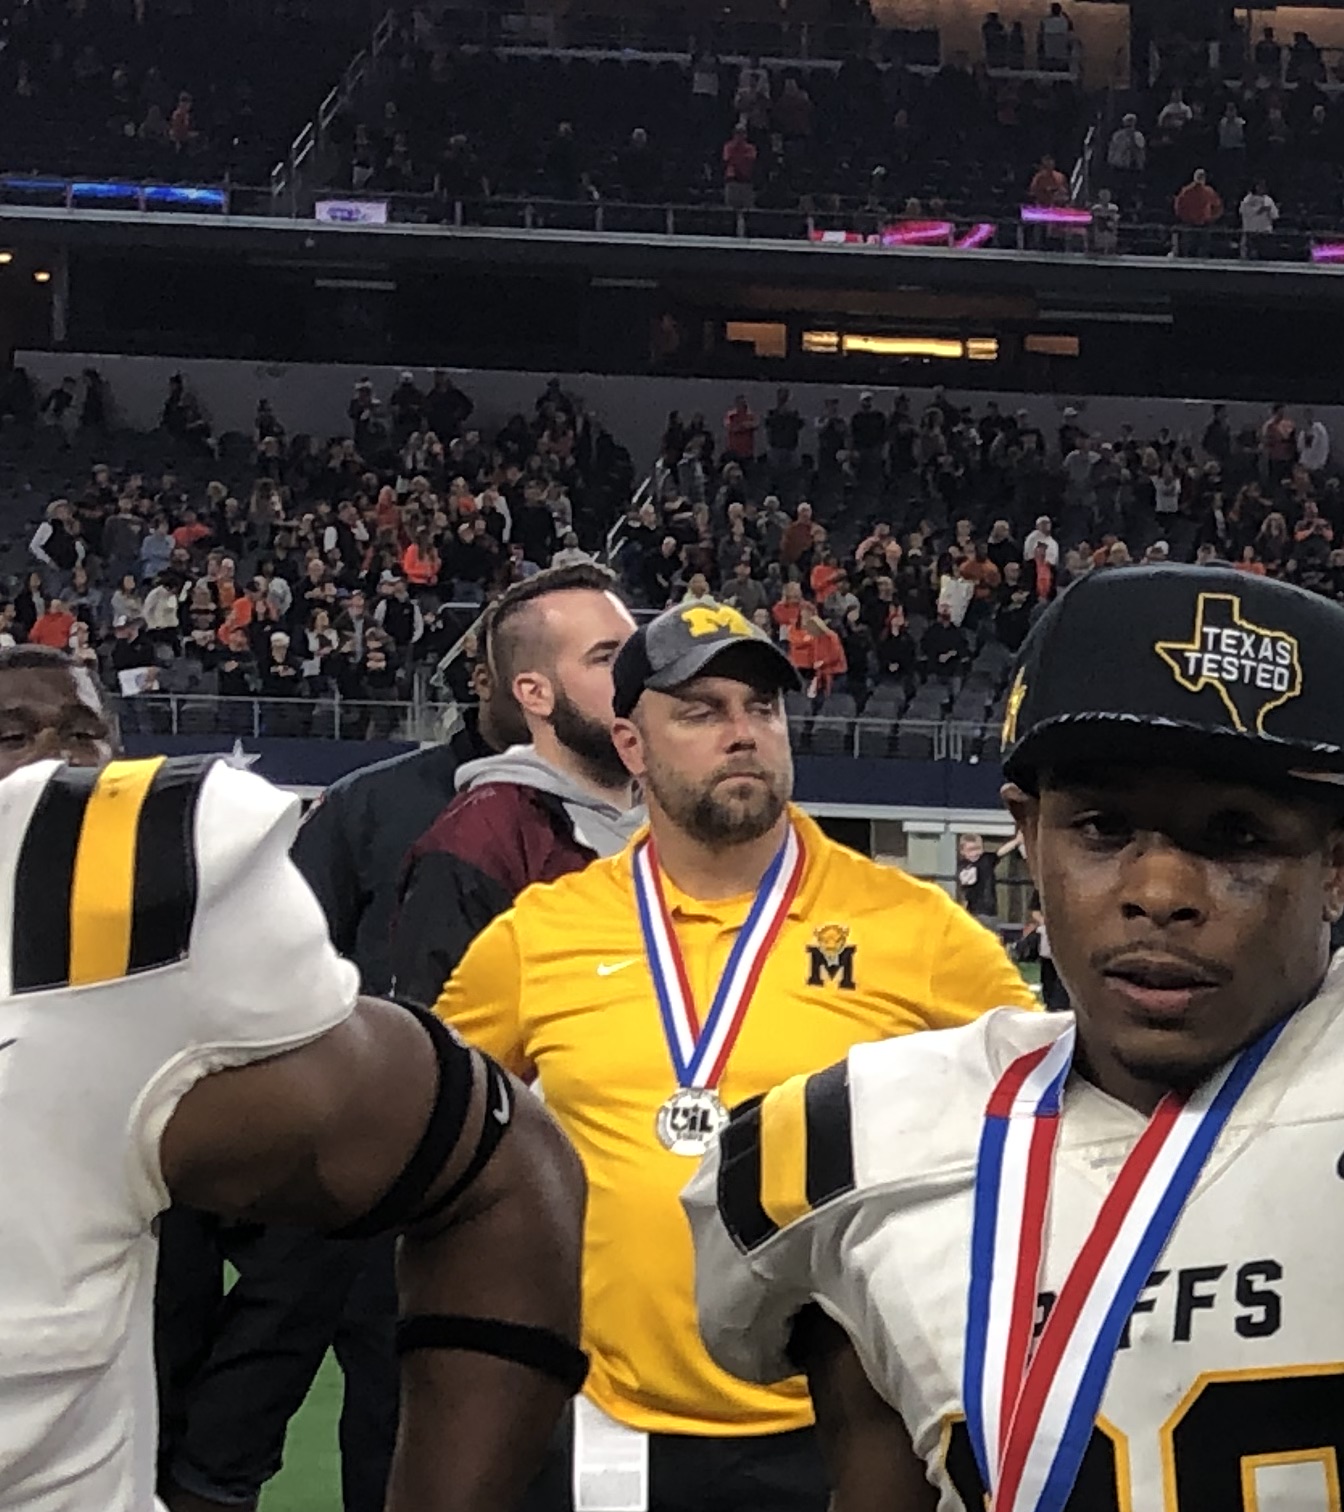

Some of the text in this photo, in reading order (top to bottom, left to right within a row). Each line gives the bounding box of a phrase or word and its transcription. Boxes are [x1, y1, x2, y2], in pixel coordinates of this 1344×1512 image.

[681, 606, 754, 638] M
[1202, 626, 1292, 666] TEXAS
[1183, 652, 1291, 693] TESTED
[804, 944, 858, 991] M
[1032, 1259, 1284, 1351] FFS
